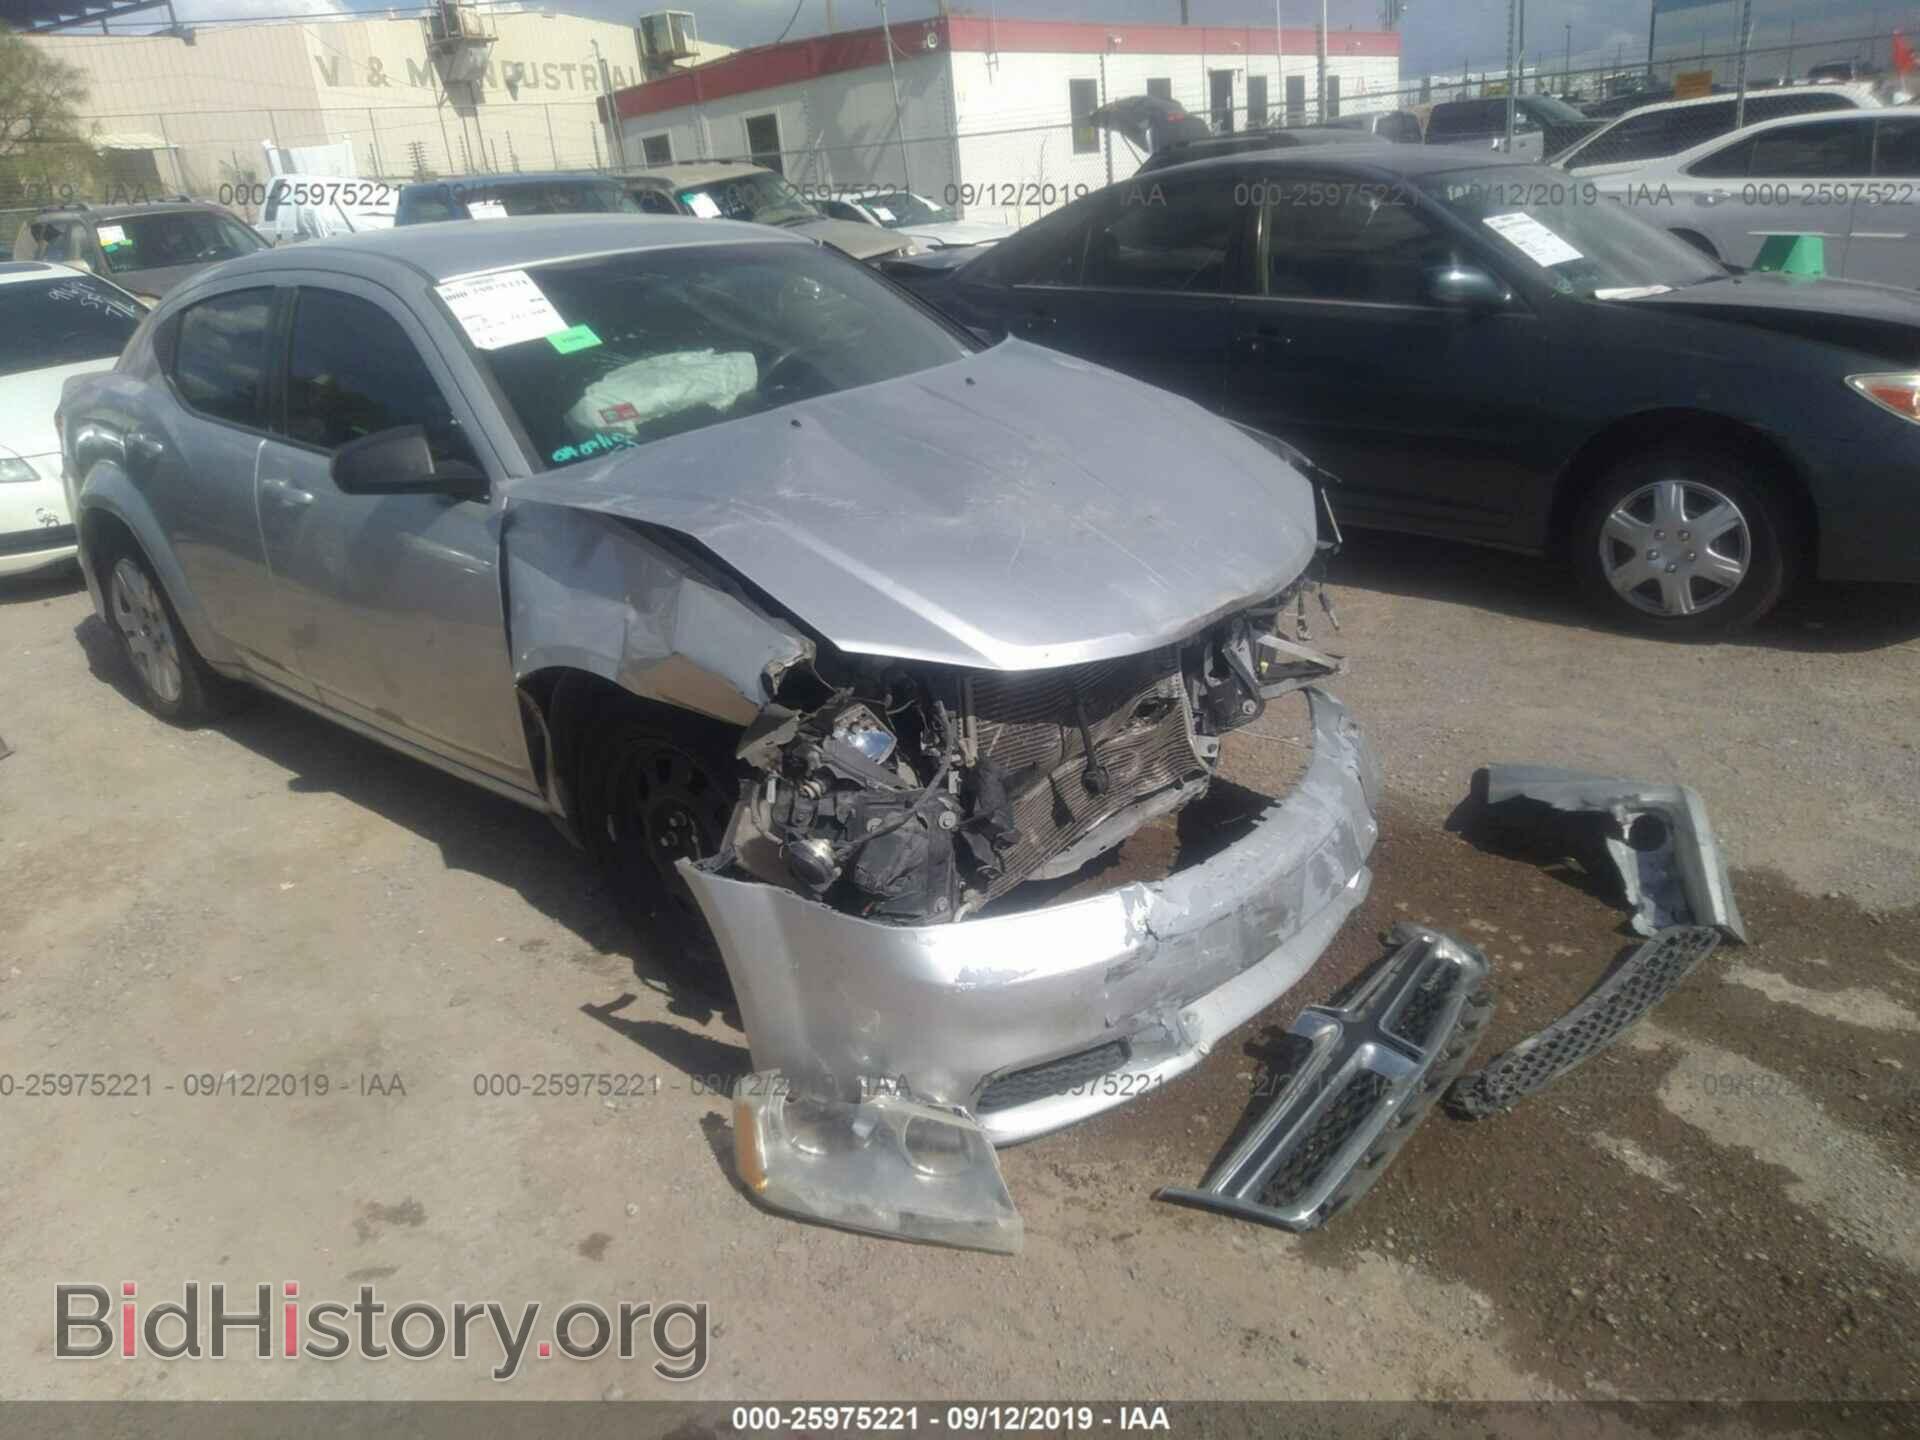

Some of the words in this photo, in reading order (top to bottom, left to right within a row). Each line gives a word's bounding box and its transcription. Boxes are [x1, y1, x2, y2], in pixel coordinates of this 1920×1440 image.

[314, 56, 339, 87] V
[367, 57, 390, 88] &
[406, 57, 435, 88] M
